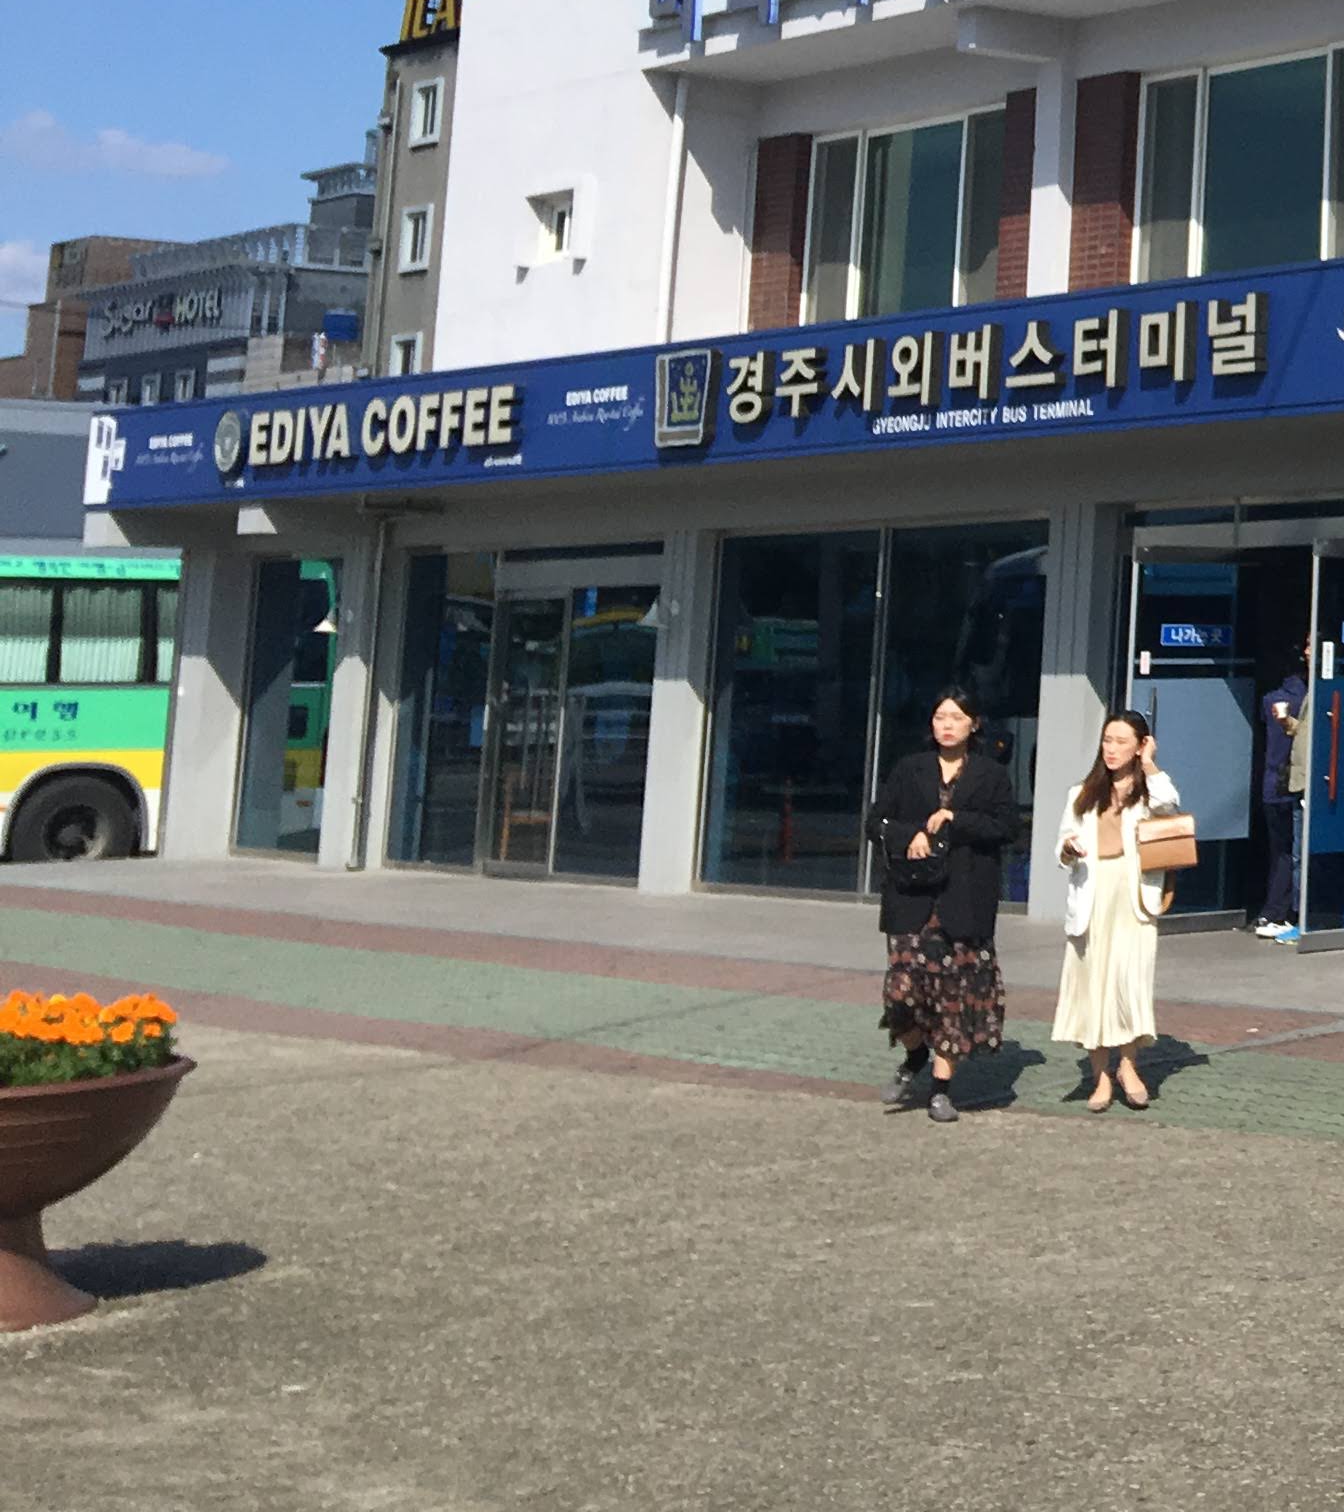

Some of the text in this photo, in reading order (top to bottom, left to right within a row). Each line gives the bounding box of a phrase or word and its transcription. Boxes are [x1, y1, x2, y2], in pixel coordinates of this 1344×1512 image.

[103, 287, 221, 336] Sugar HOTEL
[726, 292, 1257, 424] 경주시외버스터미널
[593, 385, 629, 403] COFFEE
[935, 406, 998, 430] INTERCITY
[1002, 405, 1027, 423] BUS
[1032, 397, 1095, 421] TERMINAL
[248, 403, 351, 465] EDIYA
[361, 384, 515, 456] COFFEE
